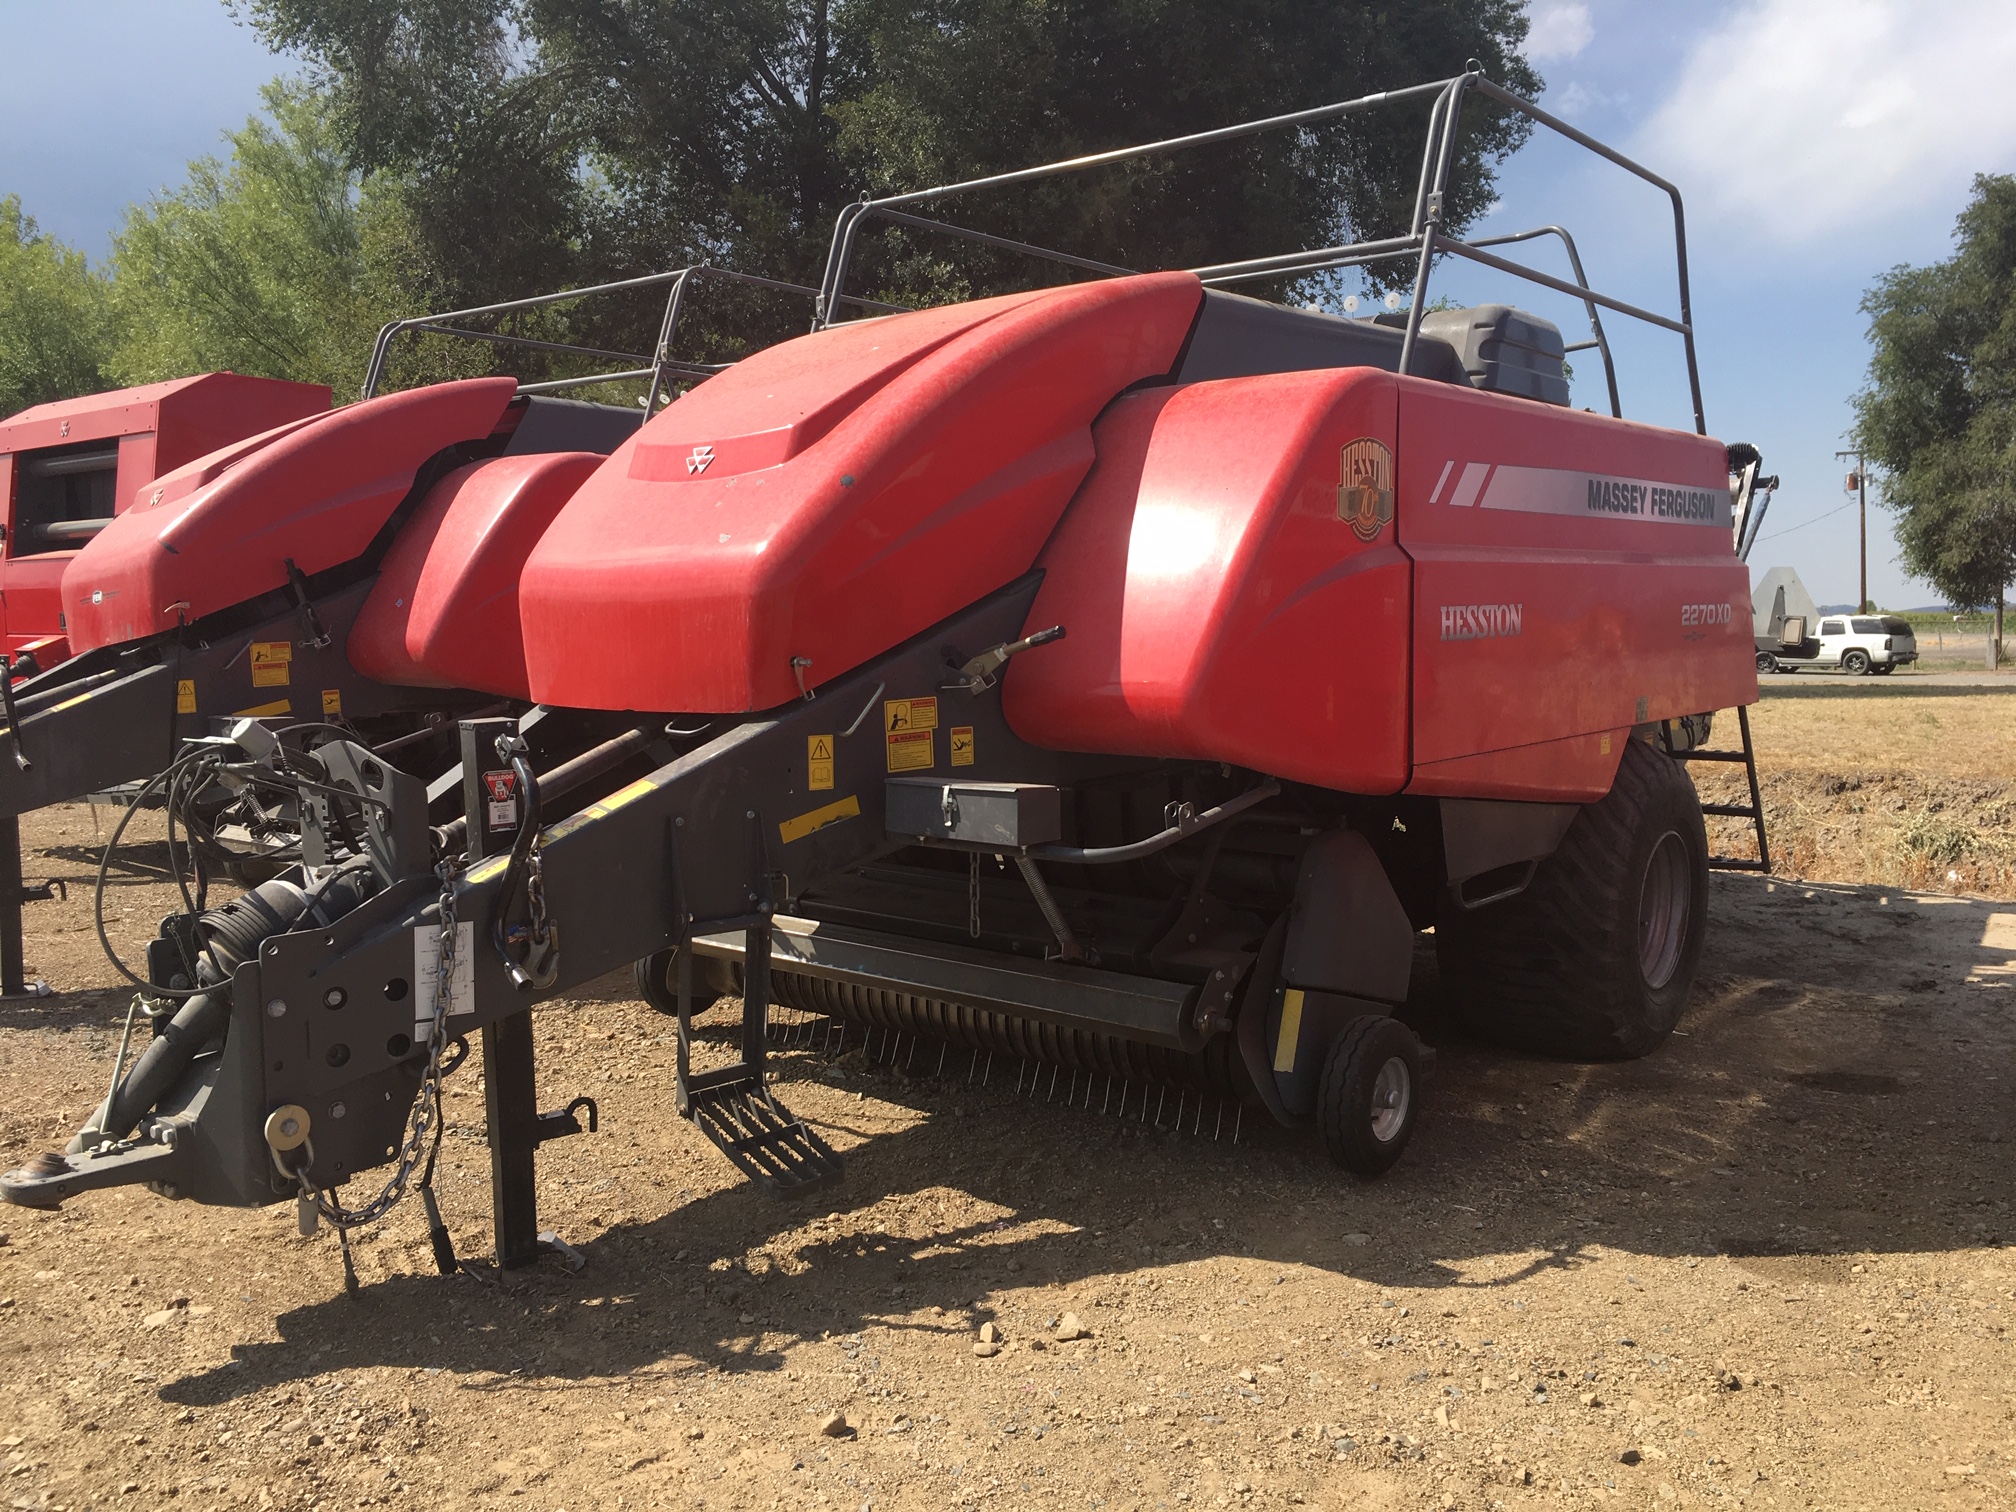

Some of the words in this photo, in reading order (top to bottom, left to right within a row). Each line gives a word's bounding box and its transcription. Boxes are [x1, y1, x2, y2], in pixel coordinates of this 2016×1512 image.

[1342, 441, 1392, 492] HESSTON
[1588, 479, 1648, 515] MASSEY
[1651, 487, 1716, 521] FERGUSON
[1440, 603, 1523, 641] HESSTON
[1681, 603, 1732, 626] 2270XD
[900, 733, 926, 741] WARNING
